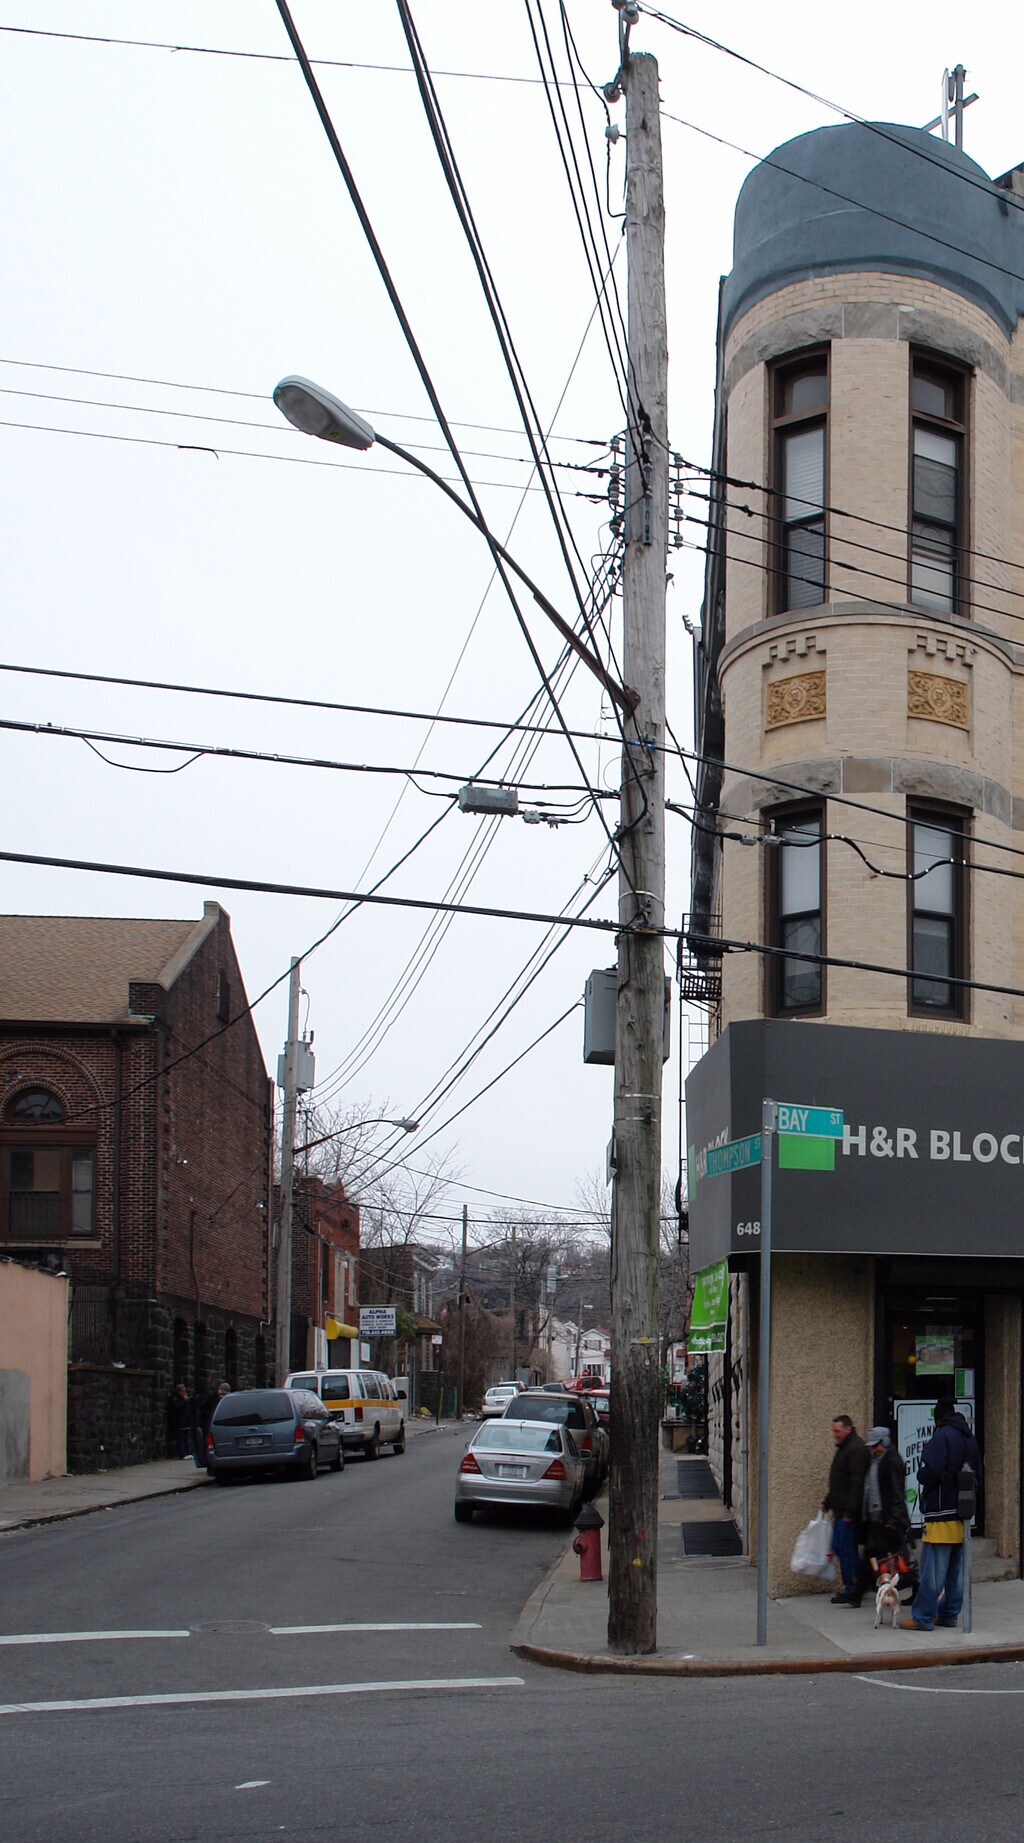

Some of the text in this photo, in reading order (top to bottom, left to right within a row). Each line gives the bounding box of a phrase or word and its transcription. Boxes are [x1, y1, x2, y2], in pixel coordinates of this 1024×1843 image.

[778, 1107, 841, 1132] BAY ST
[842, 1124, 919, 1159] H&R
[708, 1139, 751, 1174] THOMPSON
[736, 1221, 761, 1236] 648
[916, 1425, 936, 1439] YAN
[904, 1457, 924, 1476] GIV
